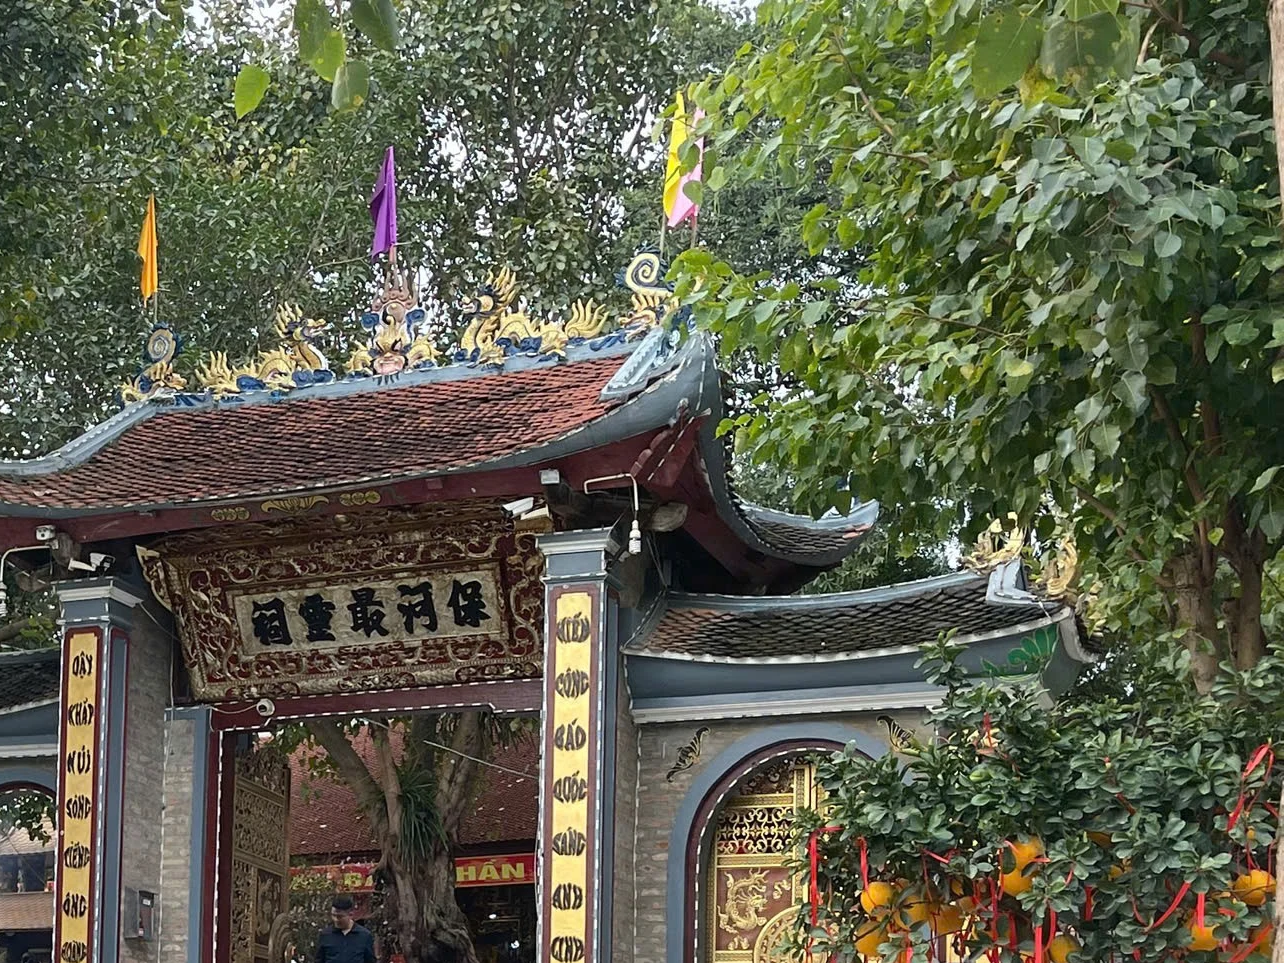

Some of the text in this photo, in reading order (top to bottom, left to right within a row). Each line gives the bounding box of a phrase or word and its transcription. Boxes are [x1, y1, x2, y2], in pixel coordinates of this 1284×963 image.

[72, 651, 93, 679] DẬY
[555, 667, 589, 700] CÔNG
[68, 697, 94, 726] KHẮP
[554, 718, 586, 751] BÁO
[67, 745, 91, 775] NÚI
[553, 770, 588, 804] QUỐC
[66, 794, 91, 820] SÔNG
[64, 841, 91, 869] TIẾNG
[552, 826, 586, 857] SÁNG
[62, 892, 87, 919] ÔNG
[551, 882, 583, 911] ANH
[551, 936, 585, 963] LINH
